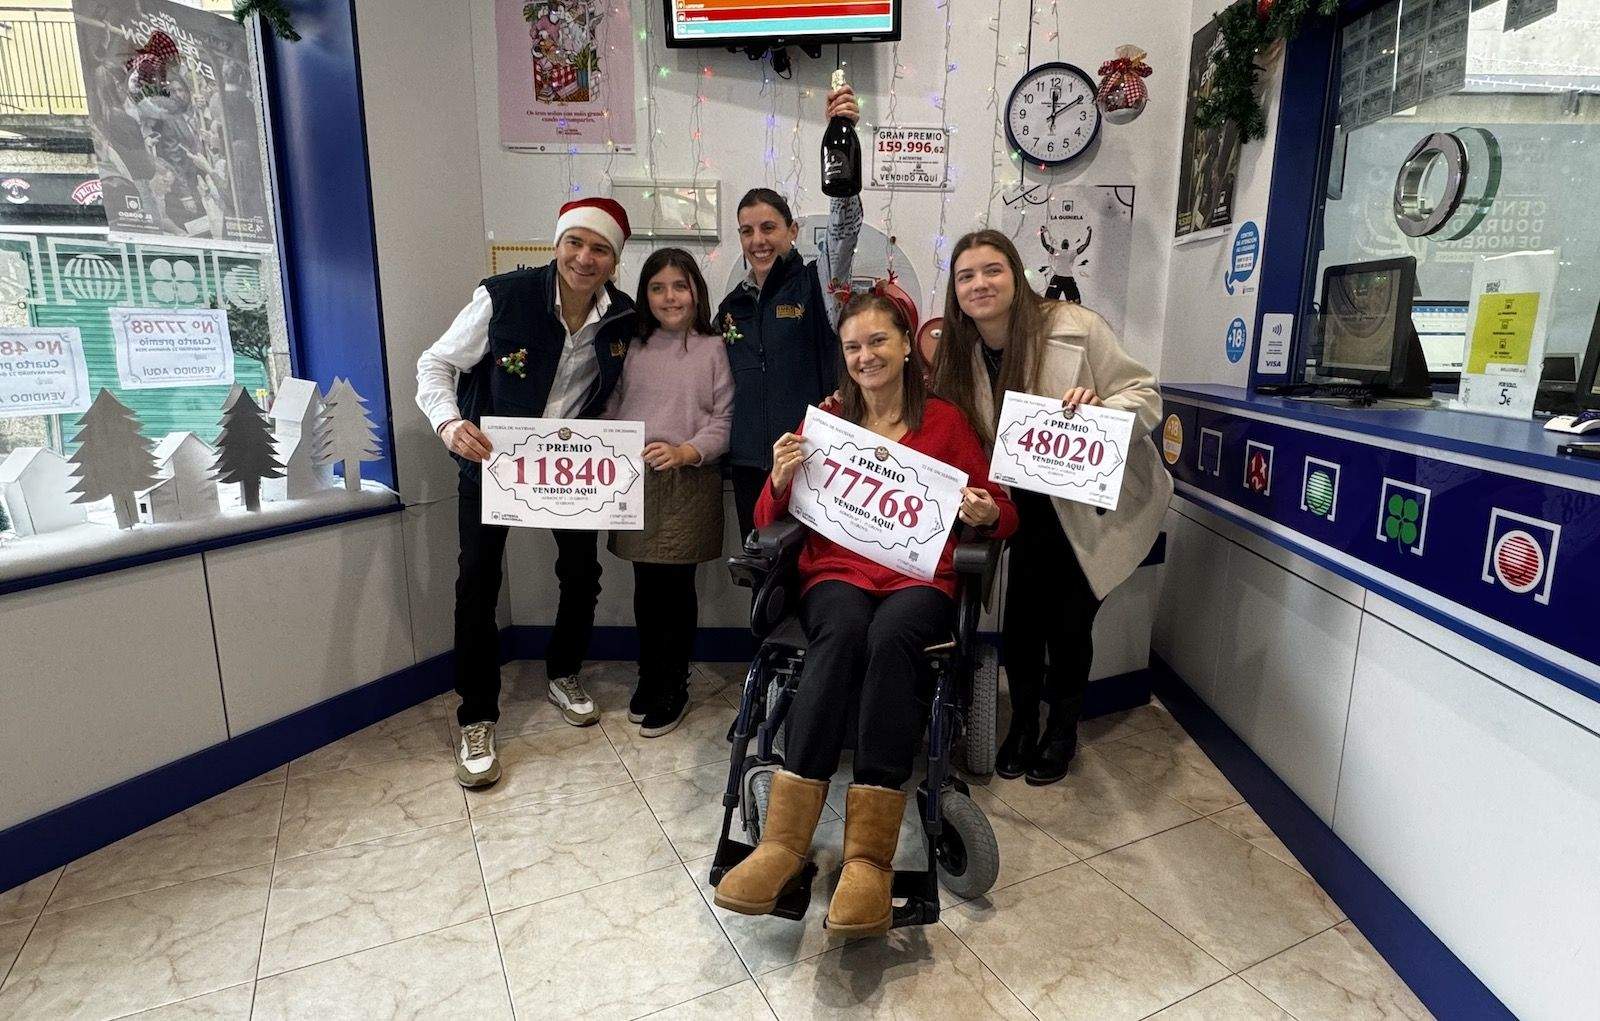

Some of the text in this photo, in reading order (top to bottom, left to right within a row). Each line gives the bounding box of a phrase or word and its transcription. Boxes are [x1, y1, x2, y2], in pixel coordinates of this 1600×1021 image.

[1036, 82, 1045, 92] 11
[1051, 78, 1060, 87] 12
[1068, 82, 1073, 92] 1
[1024, 94, 1034, 104] 10
[1020, 109, 1026, 119] 9
[1080, 111, 1086, 121] 3
[880, 132, 942, 140] GRAN PREMIO
[1022, 126, 1029, 136] 8
[1074, 127, 1081, 137] 4
[878, 141, 944, 154] 159.996,62
[1033, 137, 1040, 148] 7
[1047, 142, 1054, 152] 6
[1062, 138, 1070, 148] 5
[918, 174, 938, 182] AQUÍ
[1228, 329, 1243, 348] +18
[1499, 389, 1511, 405] 5€
[1050, 420, 1089, 433] PREMIO
[546, 444, 592, 453] PREMIO
[1018, 427, 1104, 466] 48020
[1032, 455, 1065, 467] VENDIDO
[1066, 461, 1085, 471] AQUÍ
[512, 456, 616, 486] 11840
[858, 457, 906, 484] PREMIO
[574, 487, 597, 496] AQUÍ
[823, 458, 924, 528] 77768
[834, 496, 870, 519] VENDIDO
[872, 515, 895, 531] AQUÍ
